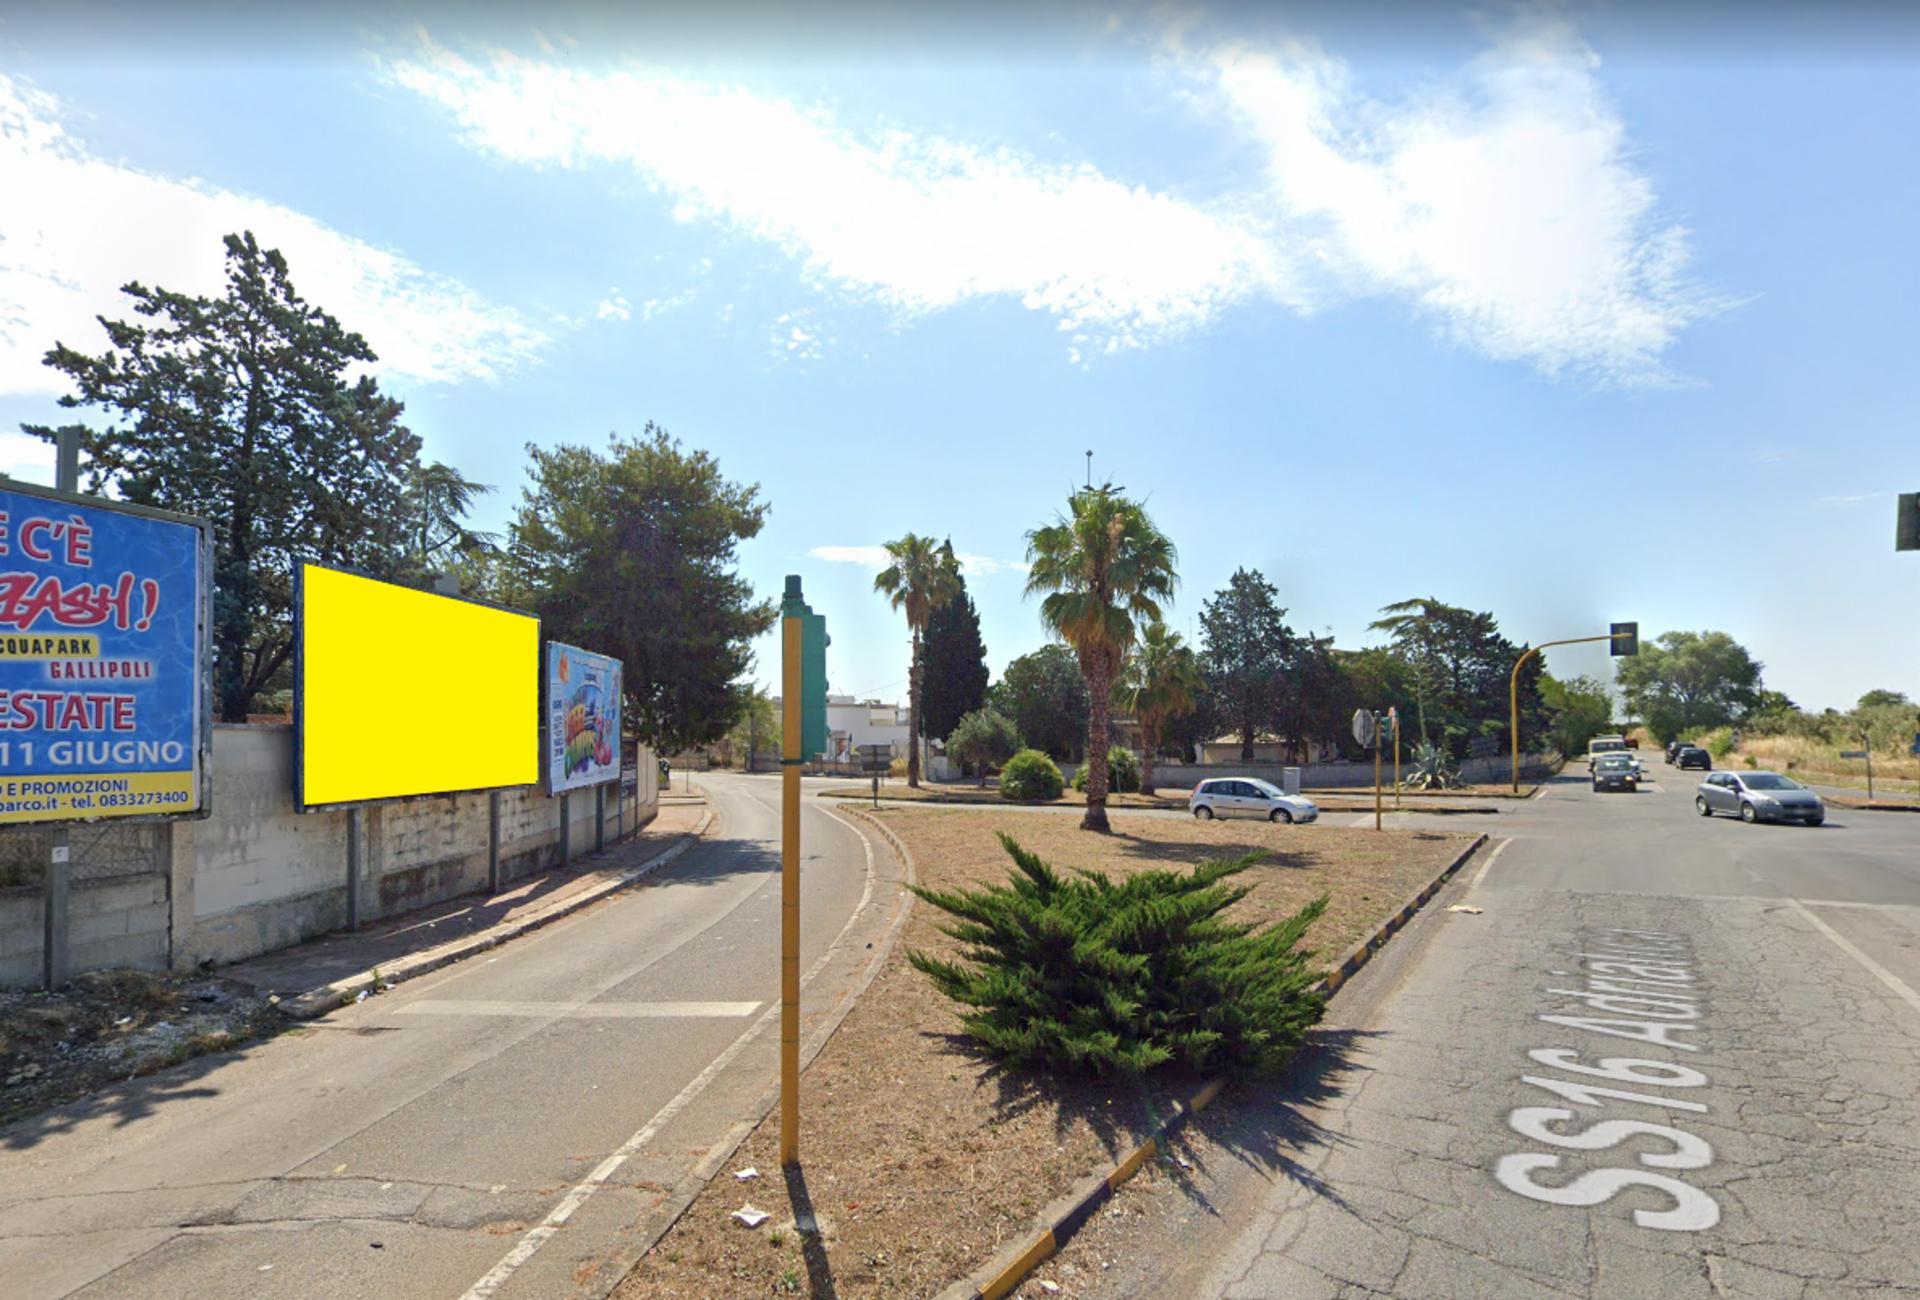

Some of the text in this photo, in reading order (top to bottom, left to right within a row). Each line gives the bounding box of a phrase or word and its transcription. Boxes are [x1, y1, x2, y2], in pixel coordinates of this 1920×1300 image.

[19, 514, 92, 567] C'È
[51, 662, 150, 678] GALLIPOLI
[48, 741, 184, 766] GIUGNO
[8, 783, 17, 796] E
[22, 780, 128, 796] PROMOZIONI
[72, 795, 96, 809] tel.
[100, 792, 188, 806] 0833273400
